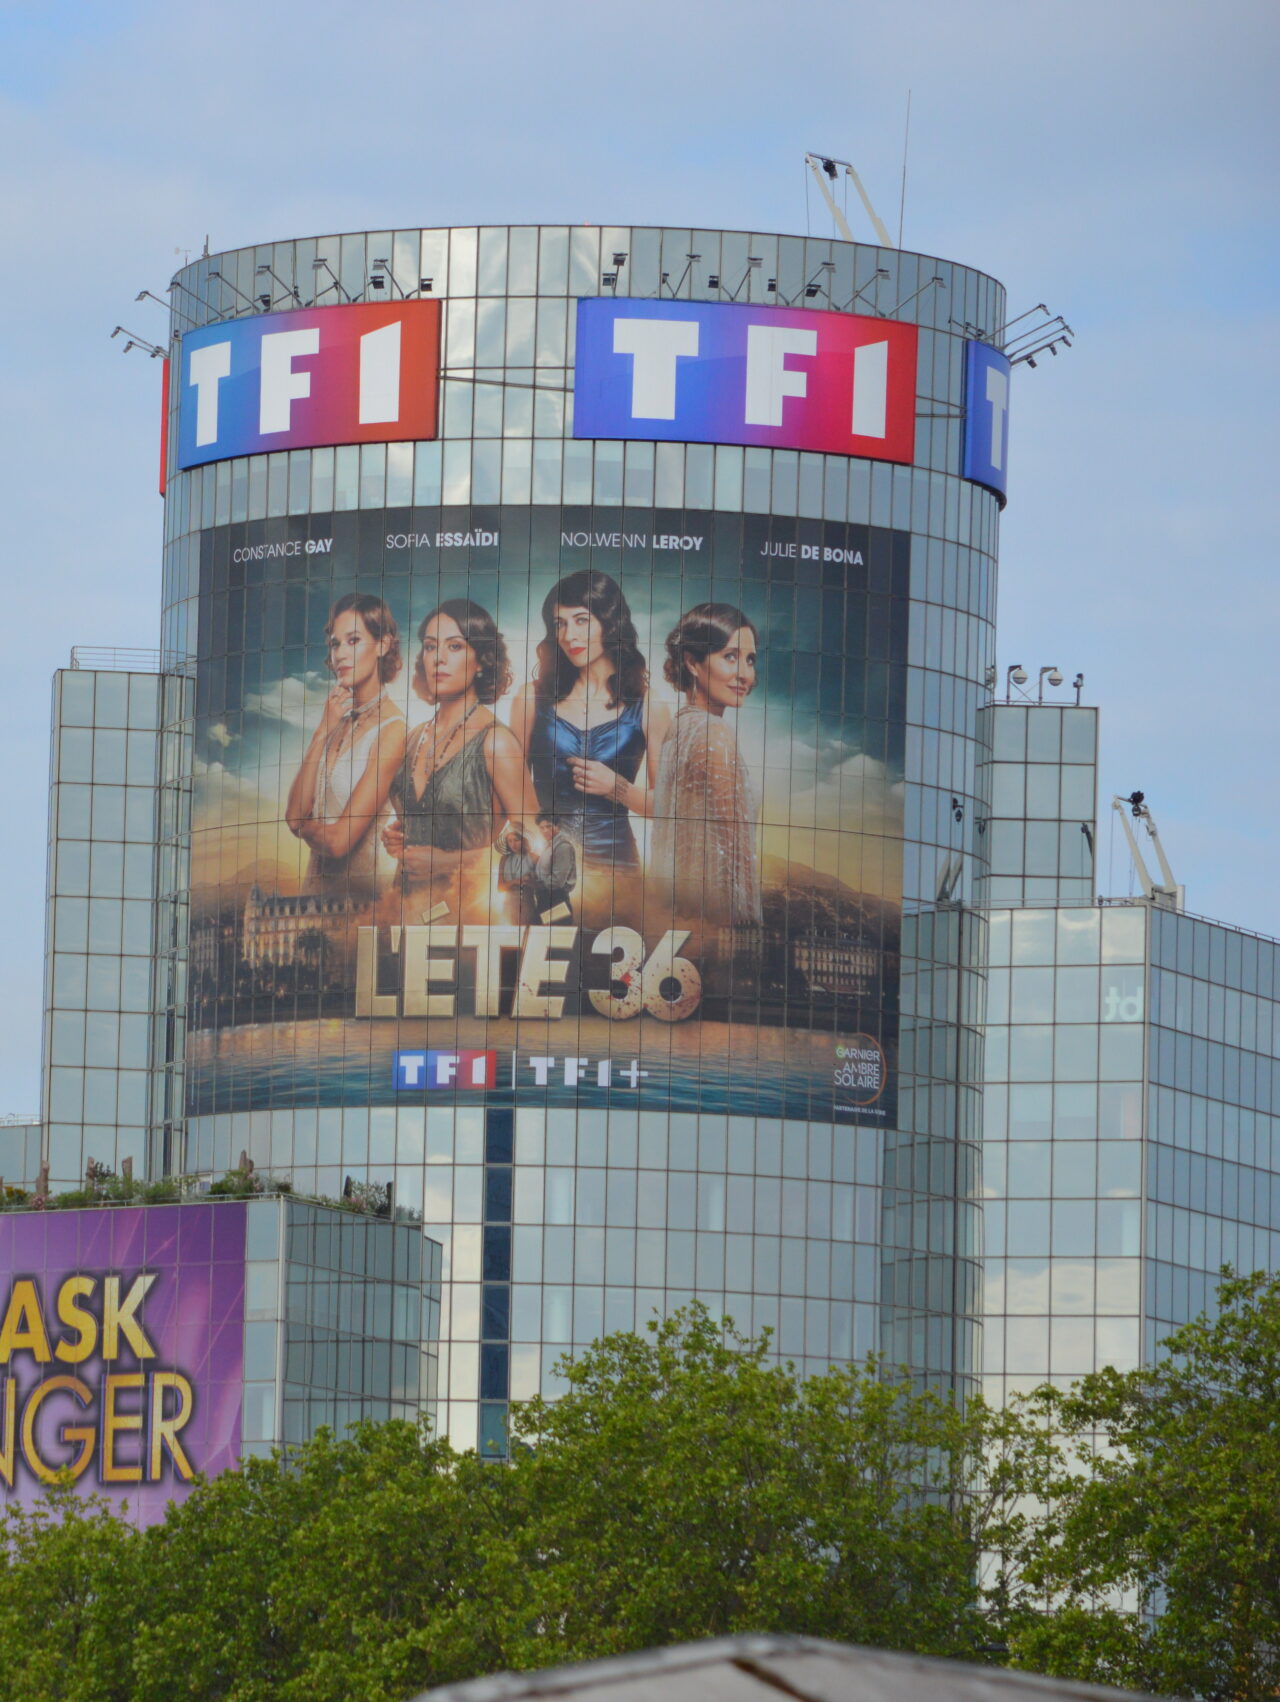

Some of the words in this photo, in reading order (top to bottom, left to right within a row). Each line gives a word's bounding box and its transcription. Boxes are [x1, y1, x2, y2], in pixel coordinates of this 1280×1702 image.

[189, 320, 402, 448] TF1
[613, 318, 888, 439] TF1
[233, 540, 302, 563] CONSTANCE
[305, 538, 333, 555] GAY
[386, 533, 431, 549] SOFIA
[435, 528, 499, 547] ESSAÏDI
[561, 532, 646, 548] NOLWENN
[652, 534, 703, 551] LEROY
[760, 541, 796, 558] JULIE
[801, 545, 819, 560] DE
[823, 547, 864, 566] BONA
[355, 901, 579, 1019] L'ÉTÉ
[588, 925, 703, 1022] 36
[398, 1055, 487, 1085] TF1
[529, 1056, 649, 1088] TF1+
[833, 1069, 880, 1089] SOLAIRE
[842, 1062, 880, 1077] AMBRE
